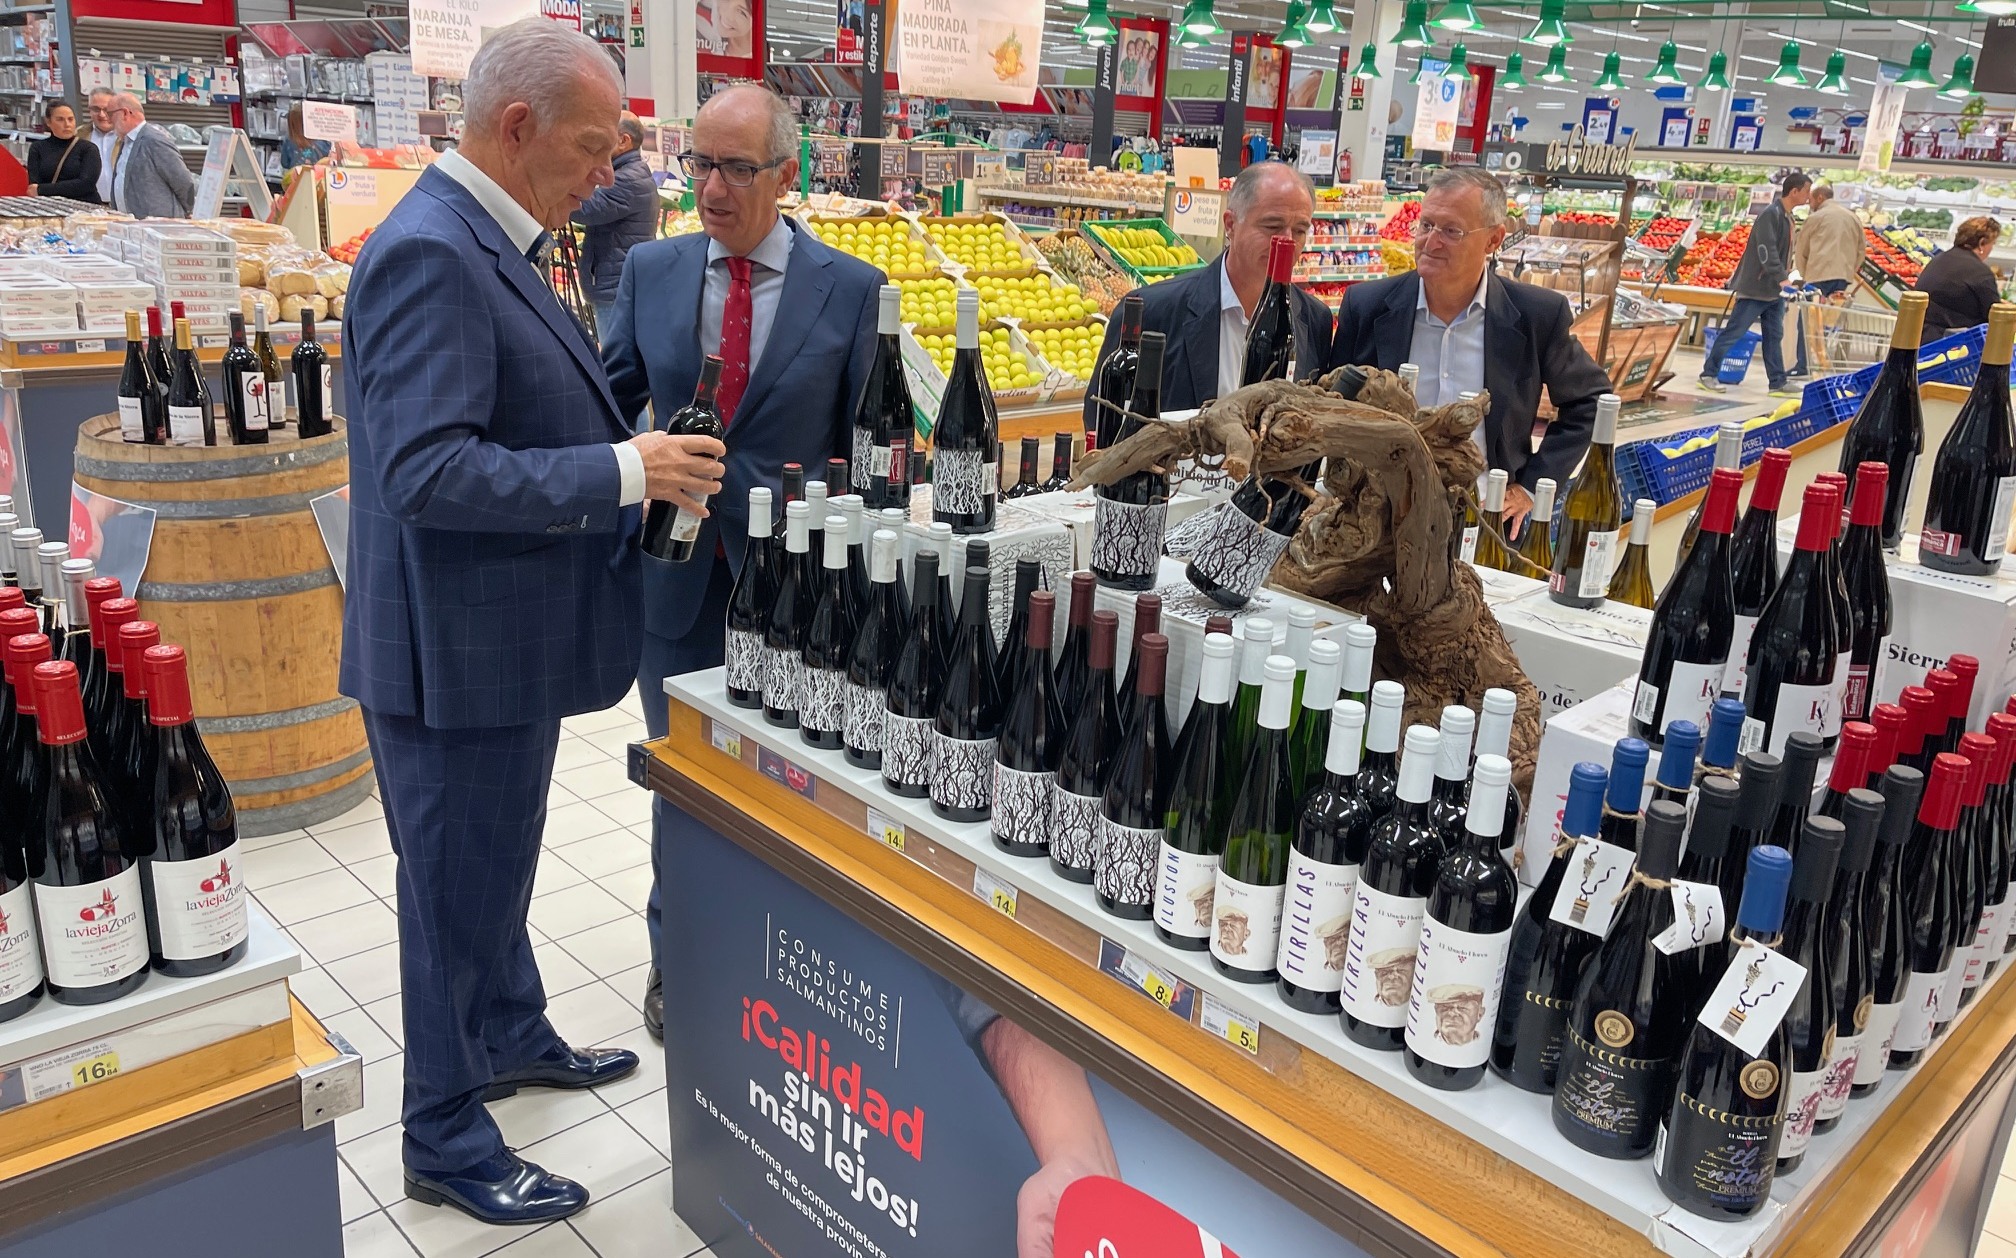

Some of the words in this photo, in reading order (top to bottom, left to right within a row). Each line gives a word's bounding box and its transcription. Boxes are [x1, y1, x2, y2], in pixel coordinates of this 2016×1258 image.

[413, 8, 472, 27] NARANJA
[417, 24, 431, 38] DE
[435, 26, 473, 42] MESA.
[541, 0, 579, 17] MODA
[903, 12, 968, 35] MADURADA
[1998, 17, 2015, 27] fruta
[867, 12, 879, 74] deporte
[904, 32, 918, 48] EN
[922, 34, 970, 54] PLANTA.
[1100, 44, 1111, 90] juvenil
[1231, 59, 1243, 103] infantil
[1743, 436, 1763, 450] PEREZ
[1224, 476, 1236, 491] la
[1553, 691, 1573, 709] de
[1286, 867, 1316, 974] TIRILLAS
[1343, 891, 1370, 1002] TIRILLAS
[777, 948, 887, 1031] PRODUCTOS
[778, 929, 888, 1011] CONSUME
[777, 968, 886, 1051] SALMANTINOS
[742, 996, 925, 1161] ¡Calidad
[695, 1087, 707, 1109] Es
[709, 1100, 718, 1118] la
[720, 1113, 749, 1144] mejor
[750, 1137, 782, 1174] forma
[784, 1166, 798, 1188] de
[784, 1070, 832, 1131] sin
[842, 1102, 868, 1153] ir
[749, 1078, 815, 1154] más
[824, 1129, 919, 1238] lejos!
[766, 1172, 779, 1191] de
[782, 1185, 824, 1230] nuestra
